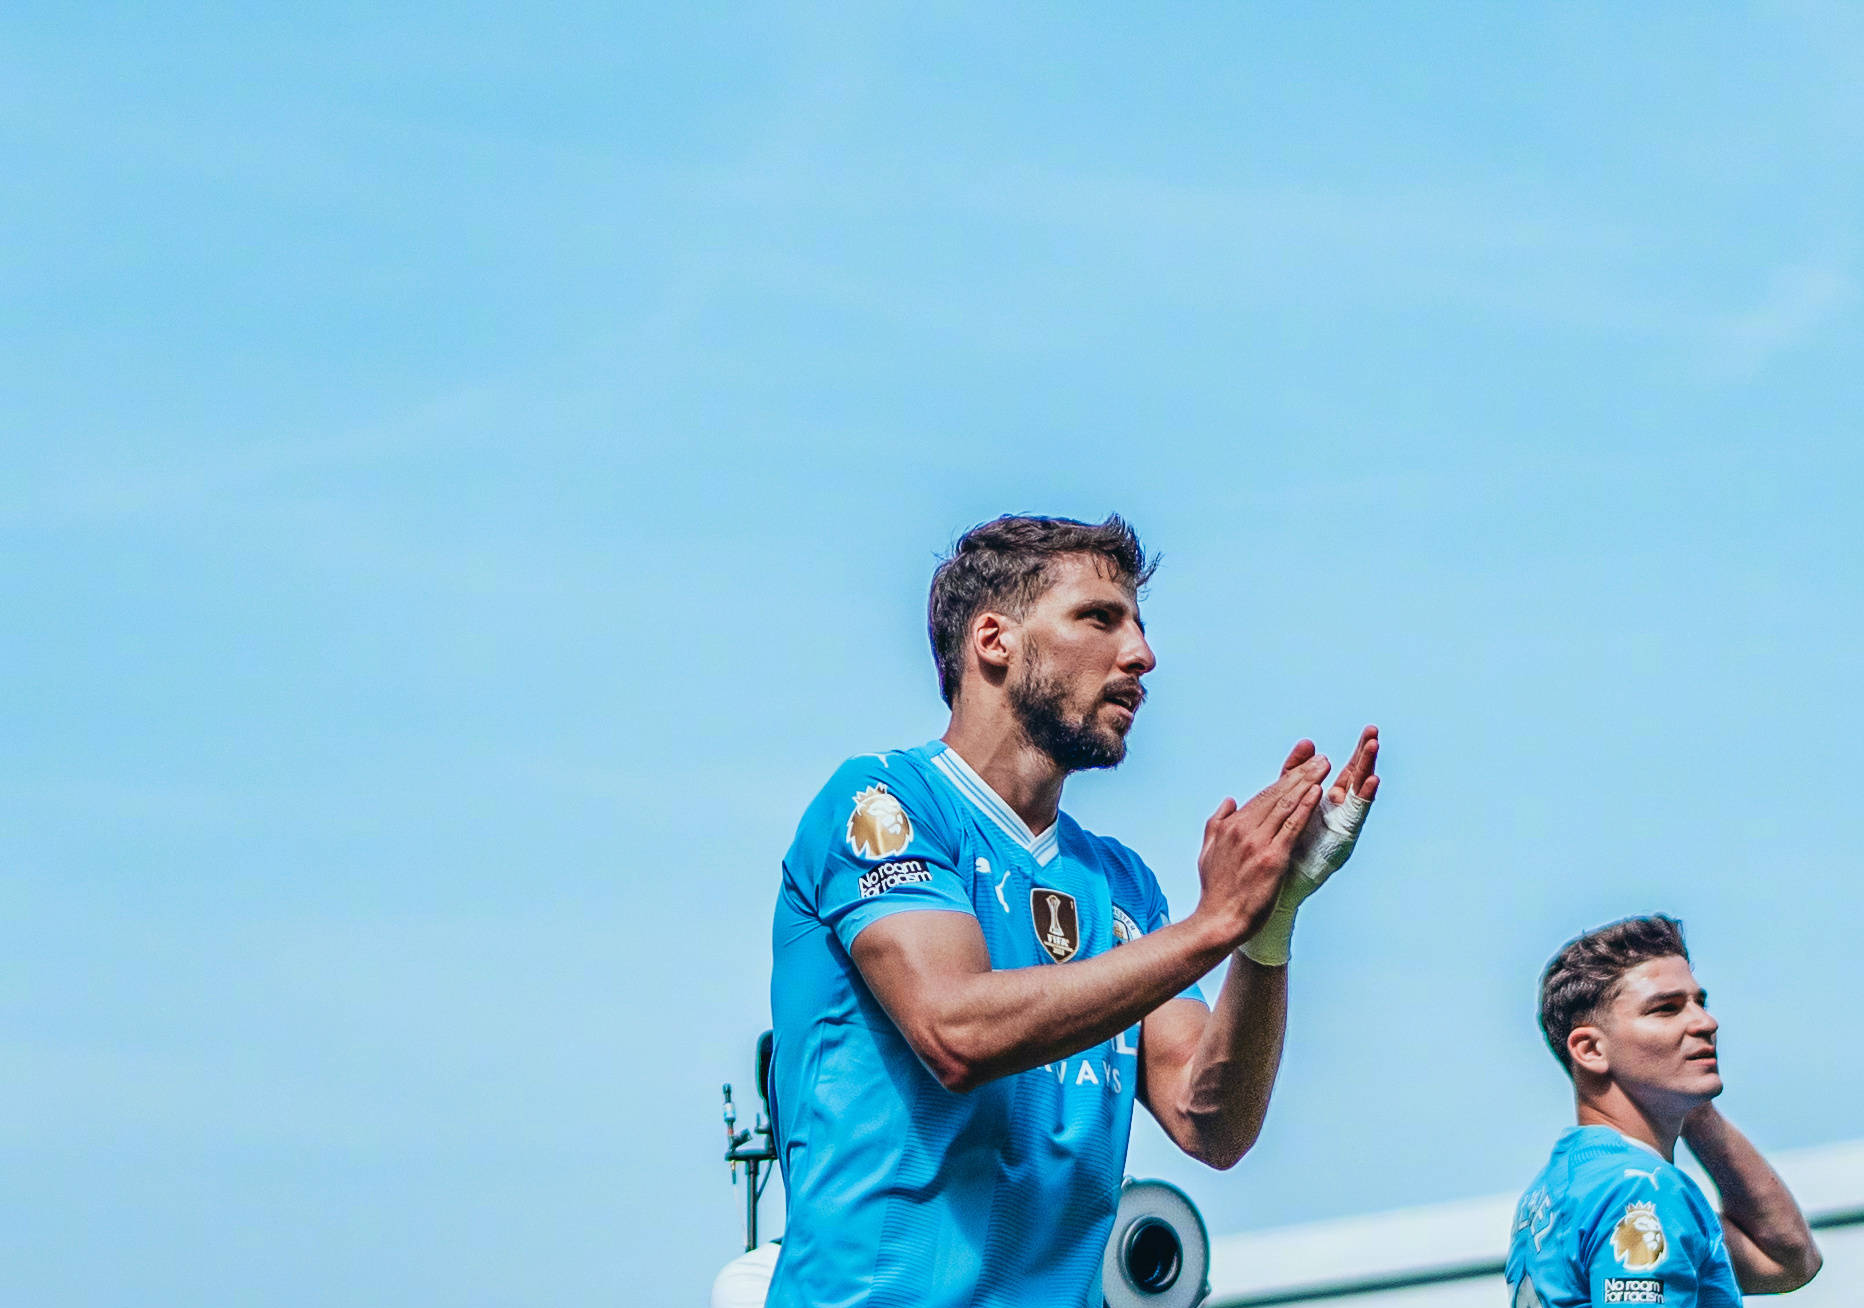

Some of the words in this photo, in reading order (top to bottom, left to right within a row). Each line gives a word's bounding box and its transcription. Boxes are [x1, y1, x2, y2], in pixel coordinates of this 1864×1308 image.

[878, 861, 921, 878] room
[1604, 1278, 1624, 1291] No
[1625, 1280, 1660, 1292] room
